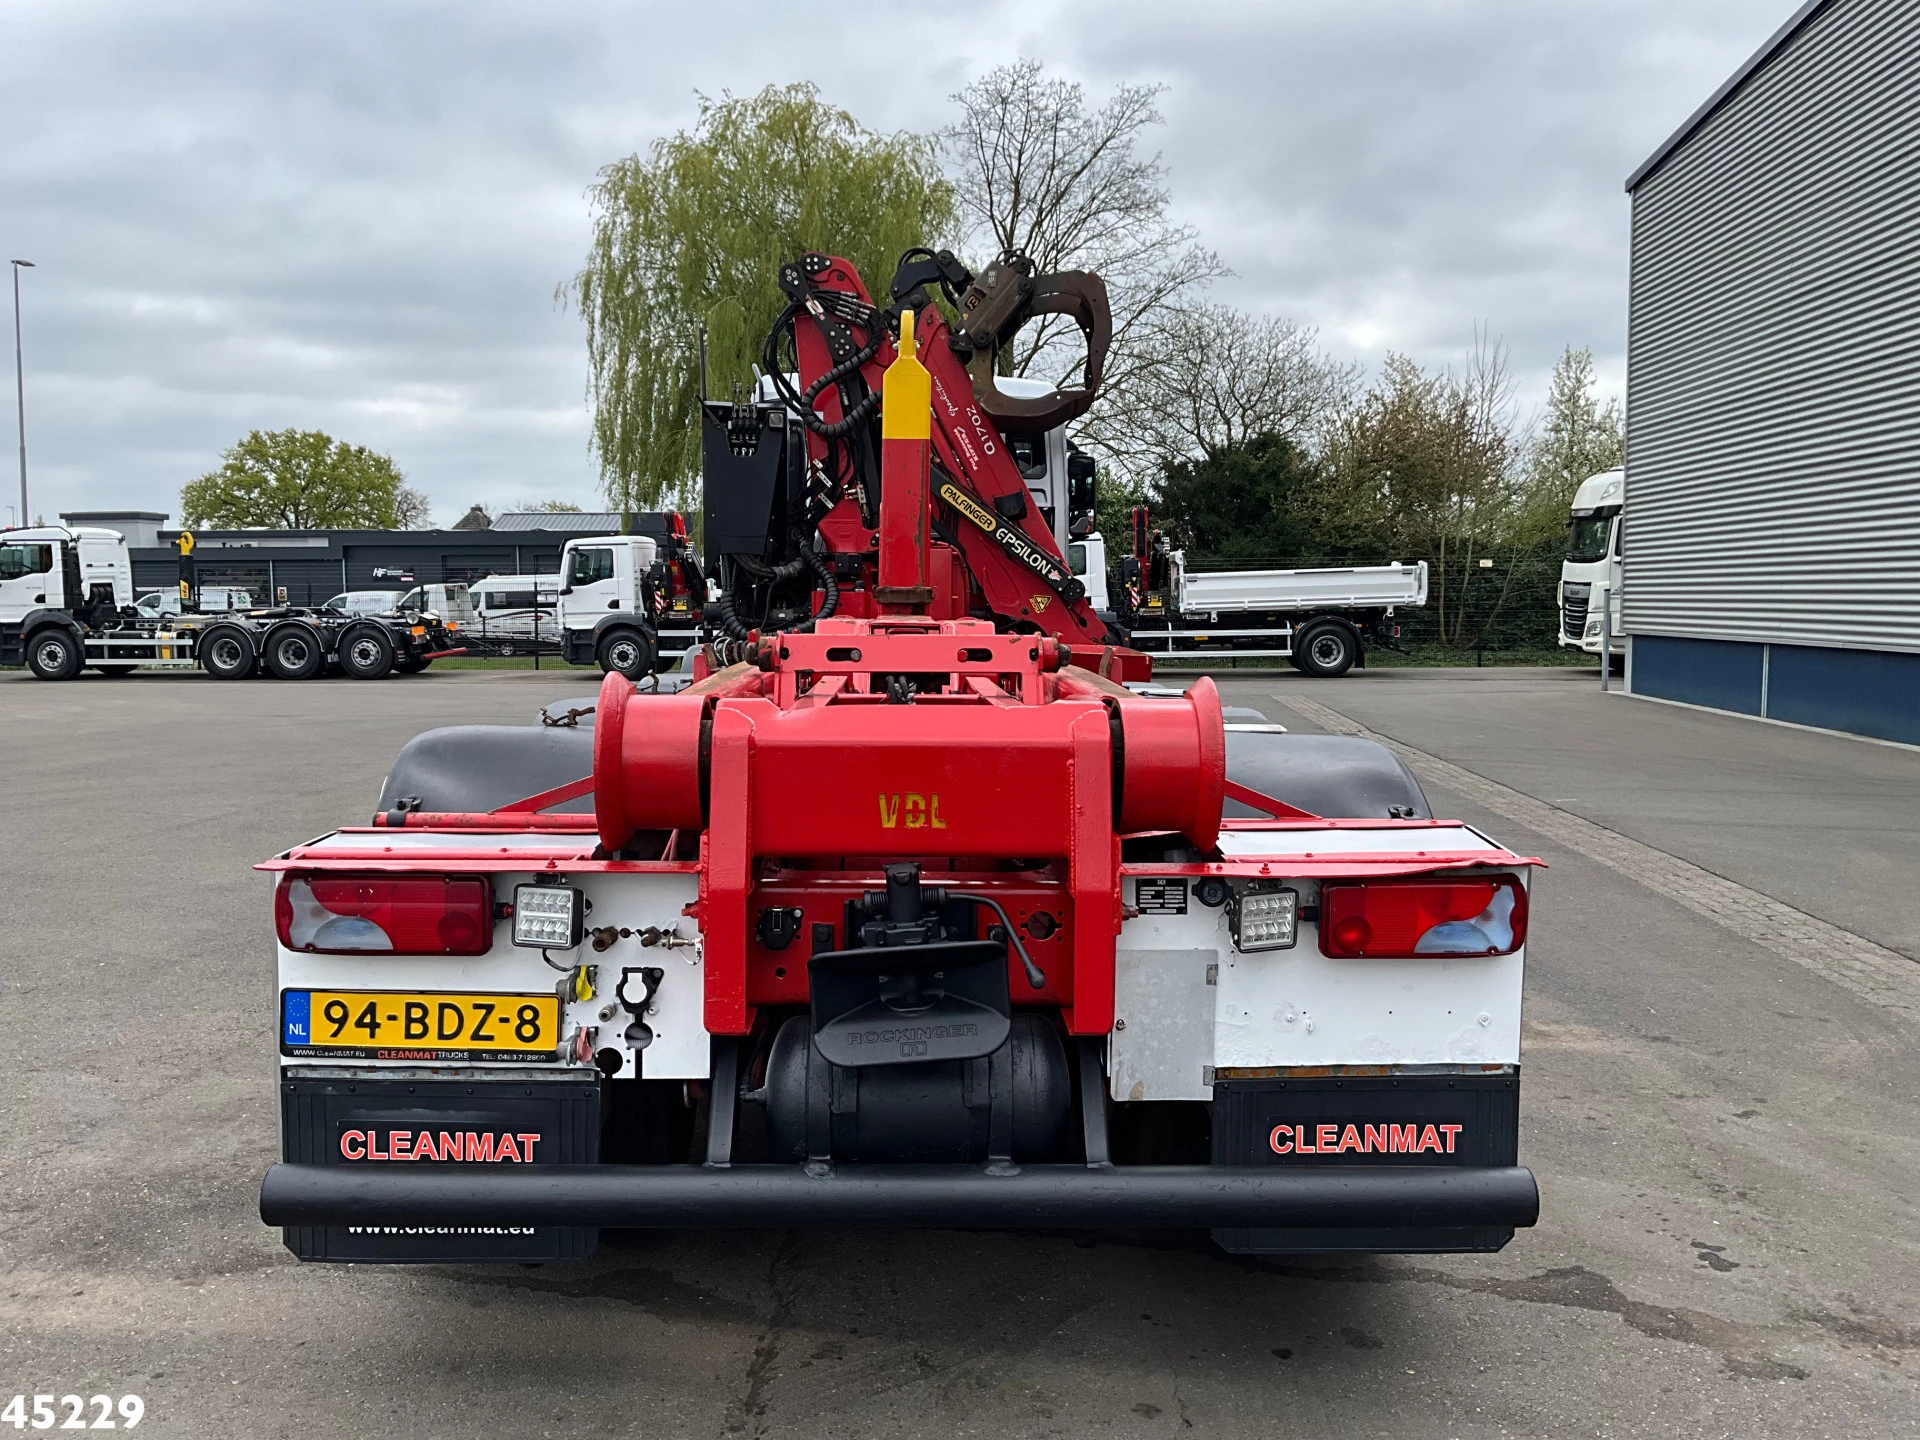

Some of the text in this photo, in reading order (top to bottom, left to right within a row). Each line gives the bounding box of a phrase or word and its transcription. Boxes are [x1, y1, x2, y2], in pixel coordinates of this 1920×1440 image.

[944, 487, 993, 529] PALFINGER
[996, 528, 1052, 575] EPSILON
[372, 567, 387, 578] HF
[878, 793, 947, 829] VDL
[289, 1023, 306, 1036] NL
[323, 999, 541, 1044] 94-BDZ-8
[848, 1023, 978, 1046] ROCKINGER
[340, 1129, 541, 1163] CLEANMAT
[1269, 1123, 1463, 1155] CLEANMAT
